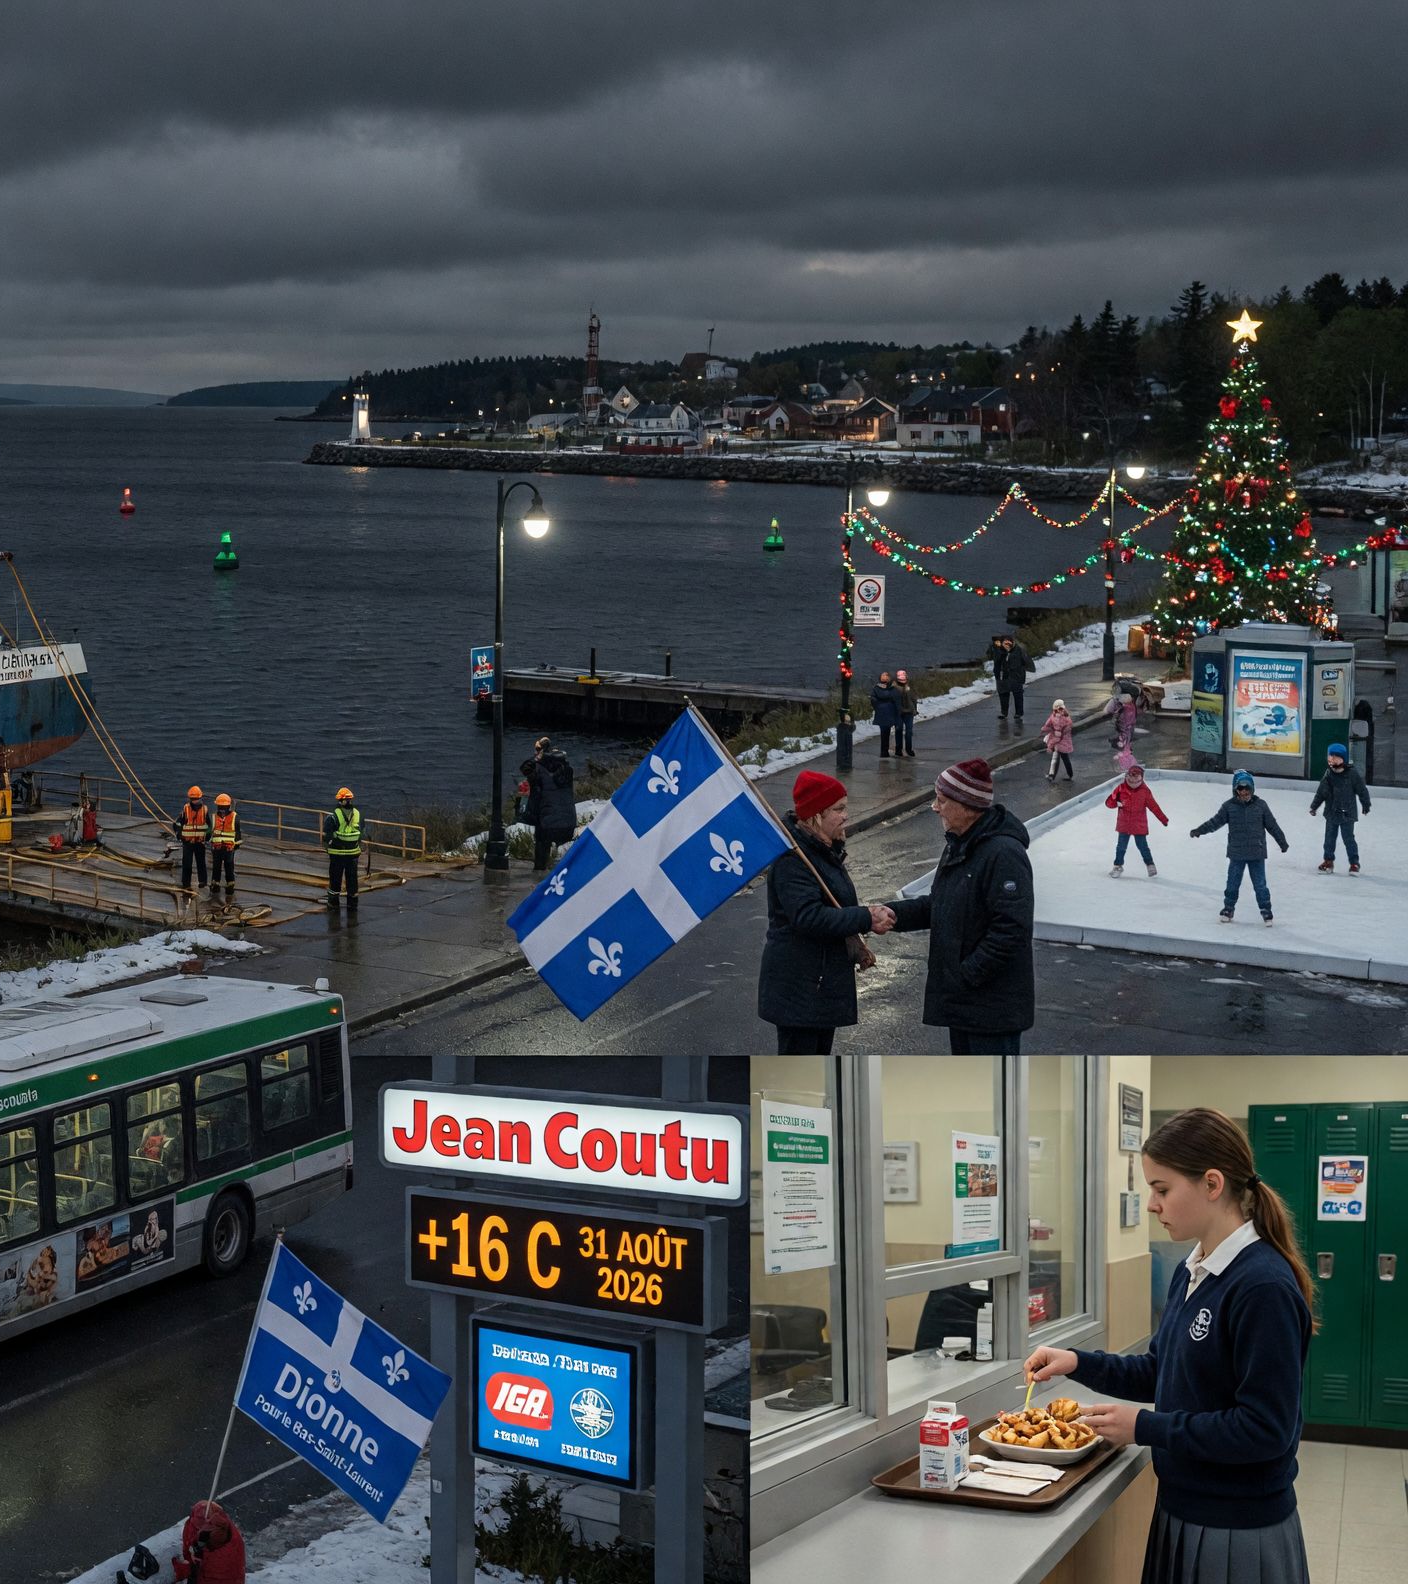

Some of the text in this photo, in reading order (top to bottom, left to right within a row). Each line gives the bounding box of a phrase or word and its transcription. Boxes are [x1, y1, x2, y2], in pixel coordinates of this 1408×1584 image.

[392, 1099, 729, 1185] Jean Coutu
[418, 1212, 561, 1289] +16 C
[578, 1226, 688, 1270] 31 AOÛT
[597, 1267, 663, 1306] 2026
[273, 1362, 379, 1466] Dionne
[493, 1382, 547, 1418] IGA
